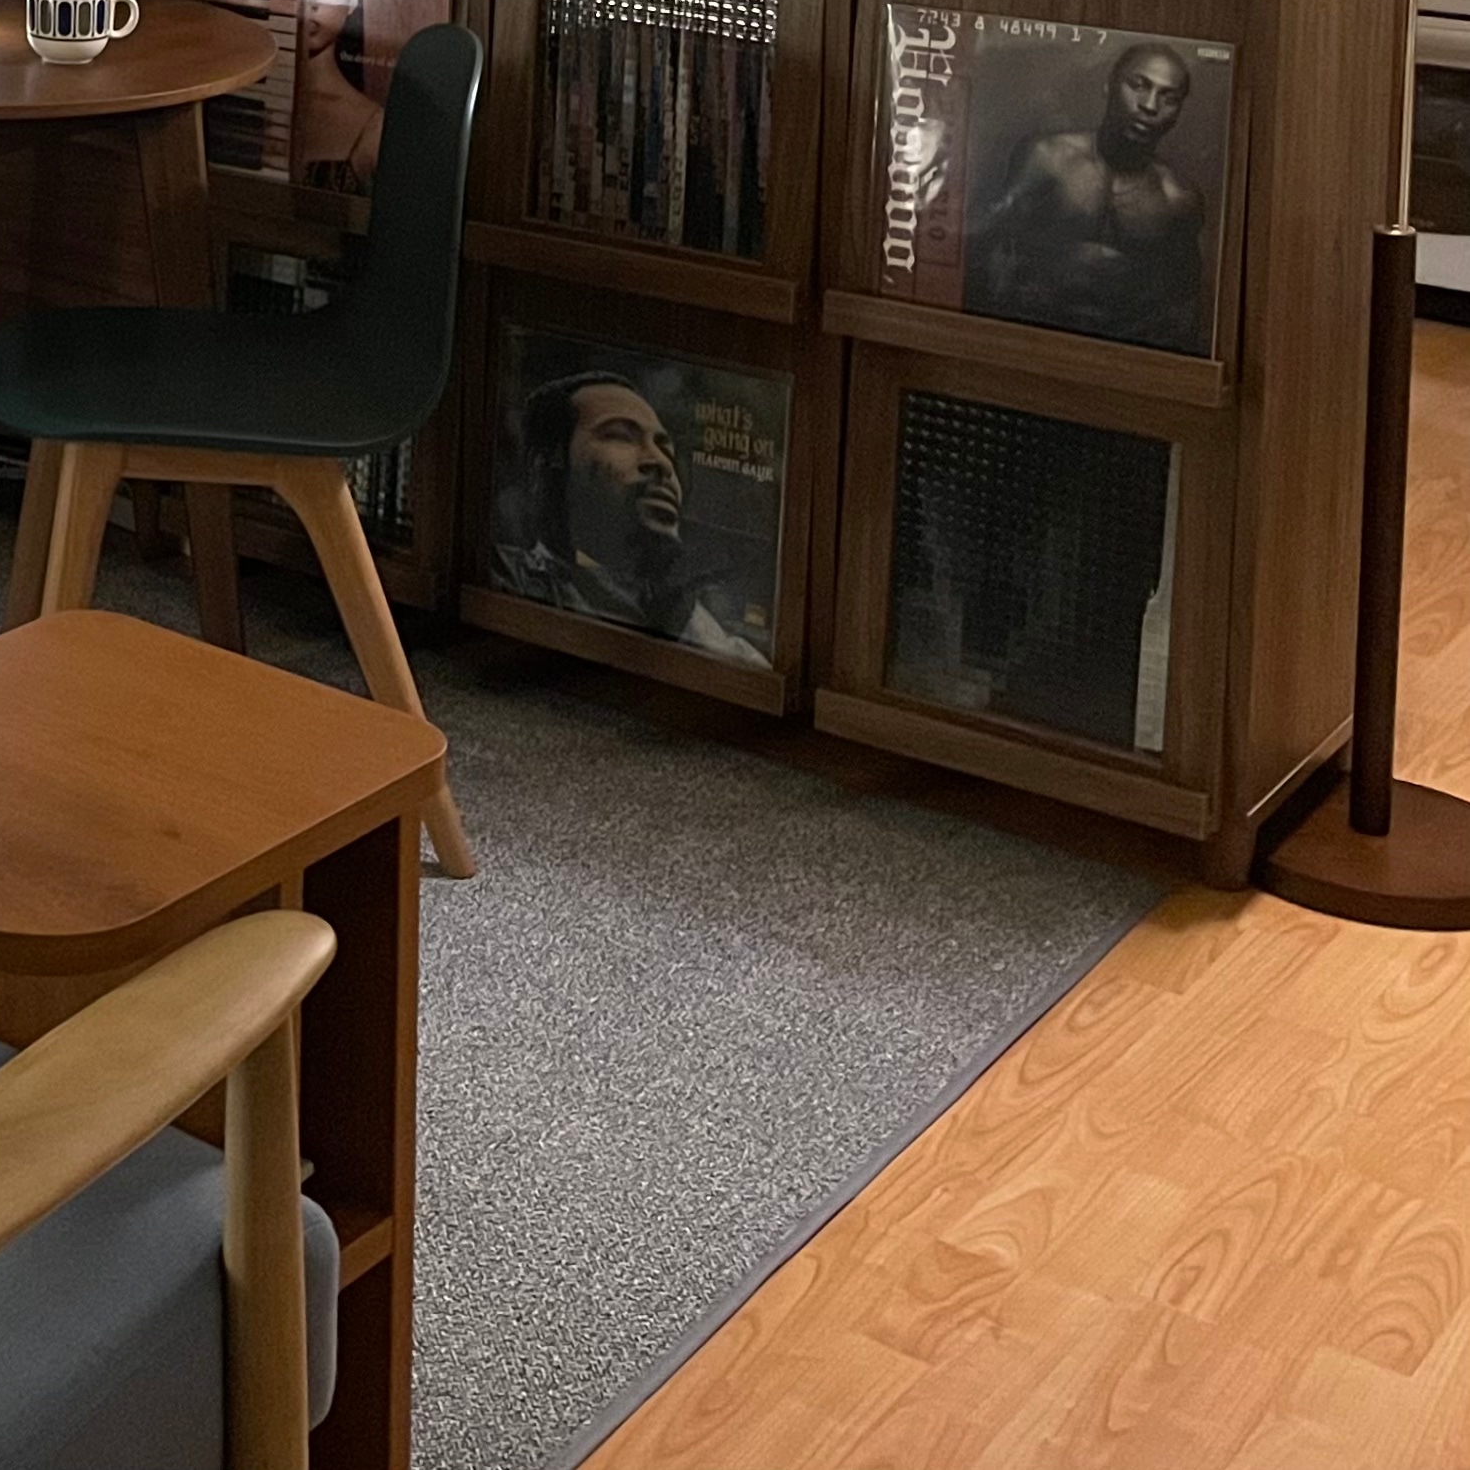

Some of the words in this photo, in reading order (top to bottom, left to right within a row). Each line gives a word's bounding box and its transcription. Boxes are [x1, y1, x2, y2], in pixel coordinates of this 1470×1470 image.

[917, 8, 961, 27] 7243
[974, 15, 985, 30] 8
[1000, 19, 1057, 40] 48499
[1071, 27, 1081, 42] 1
[1097, 30, 1107, 45] 7
